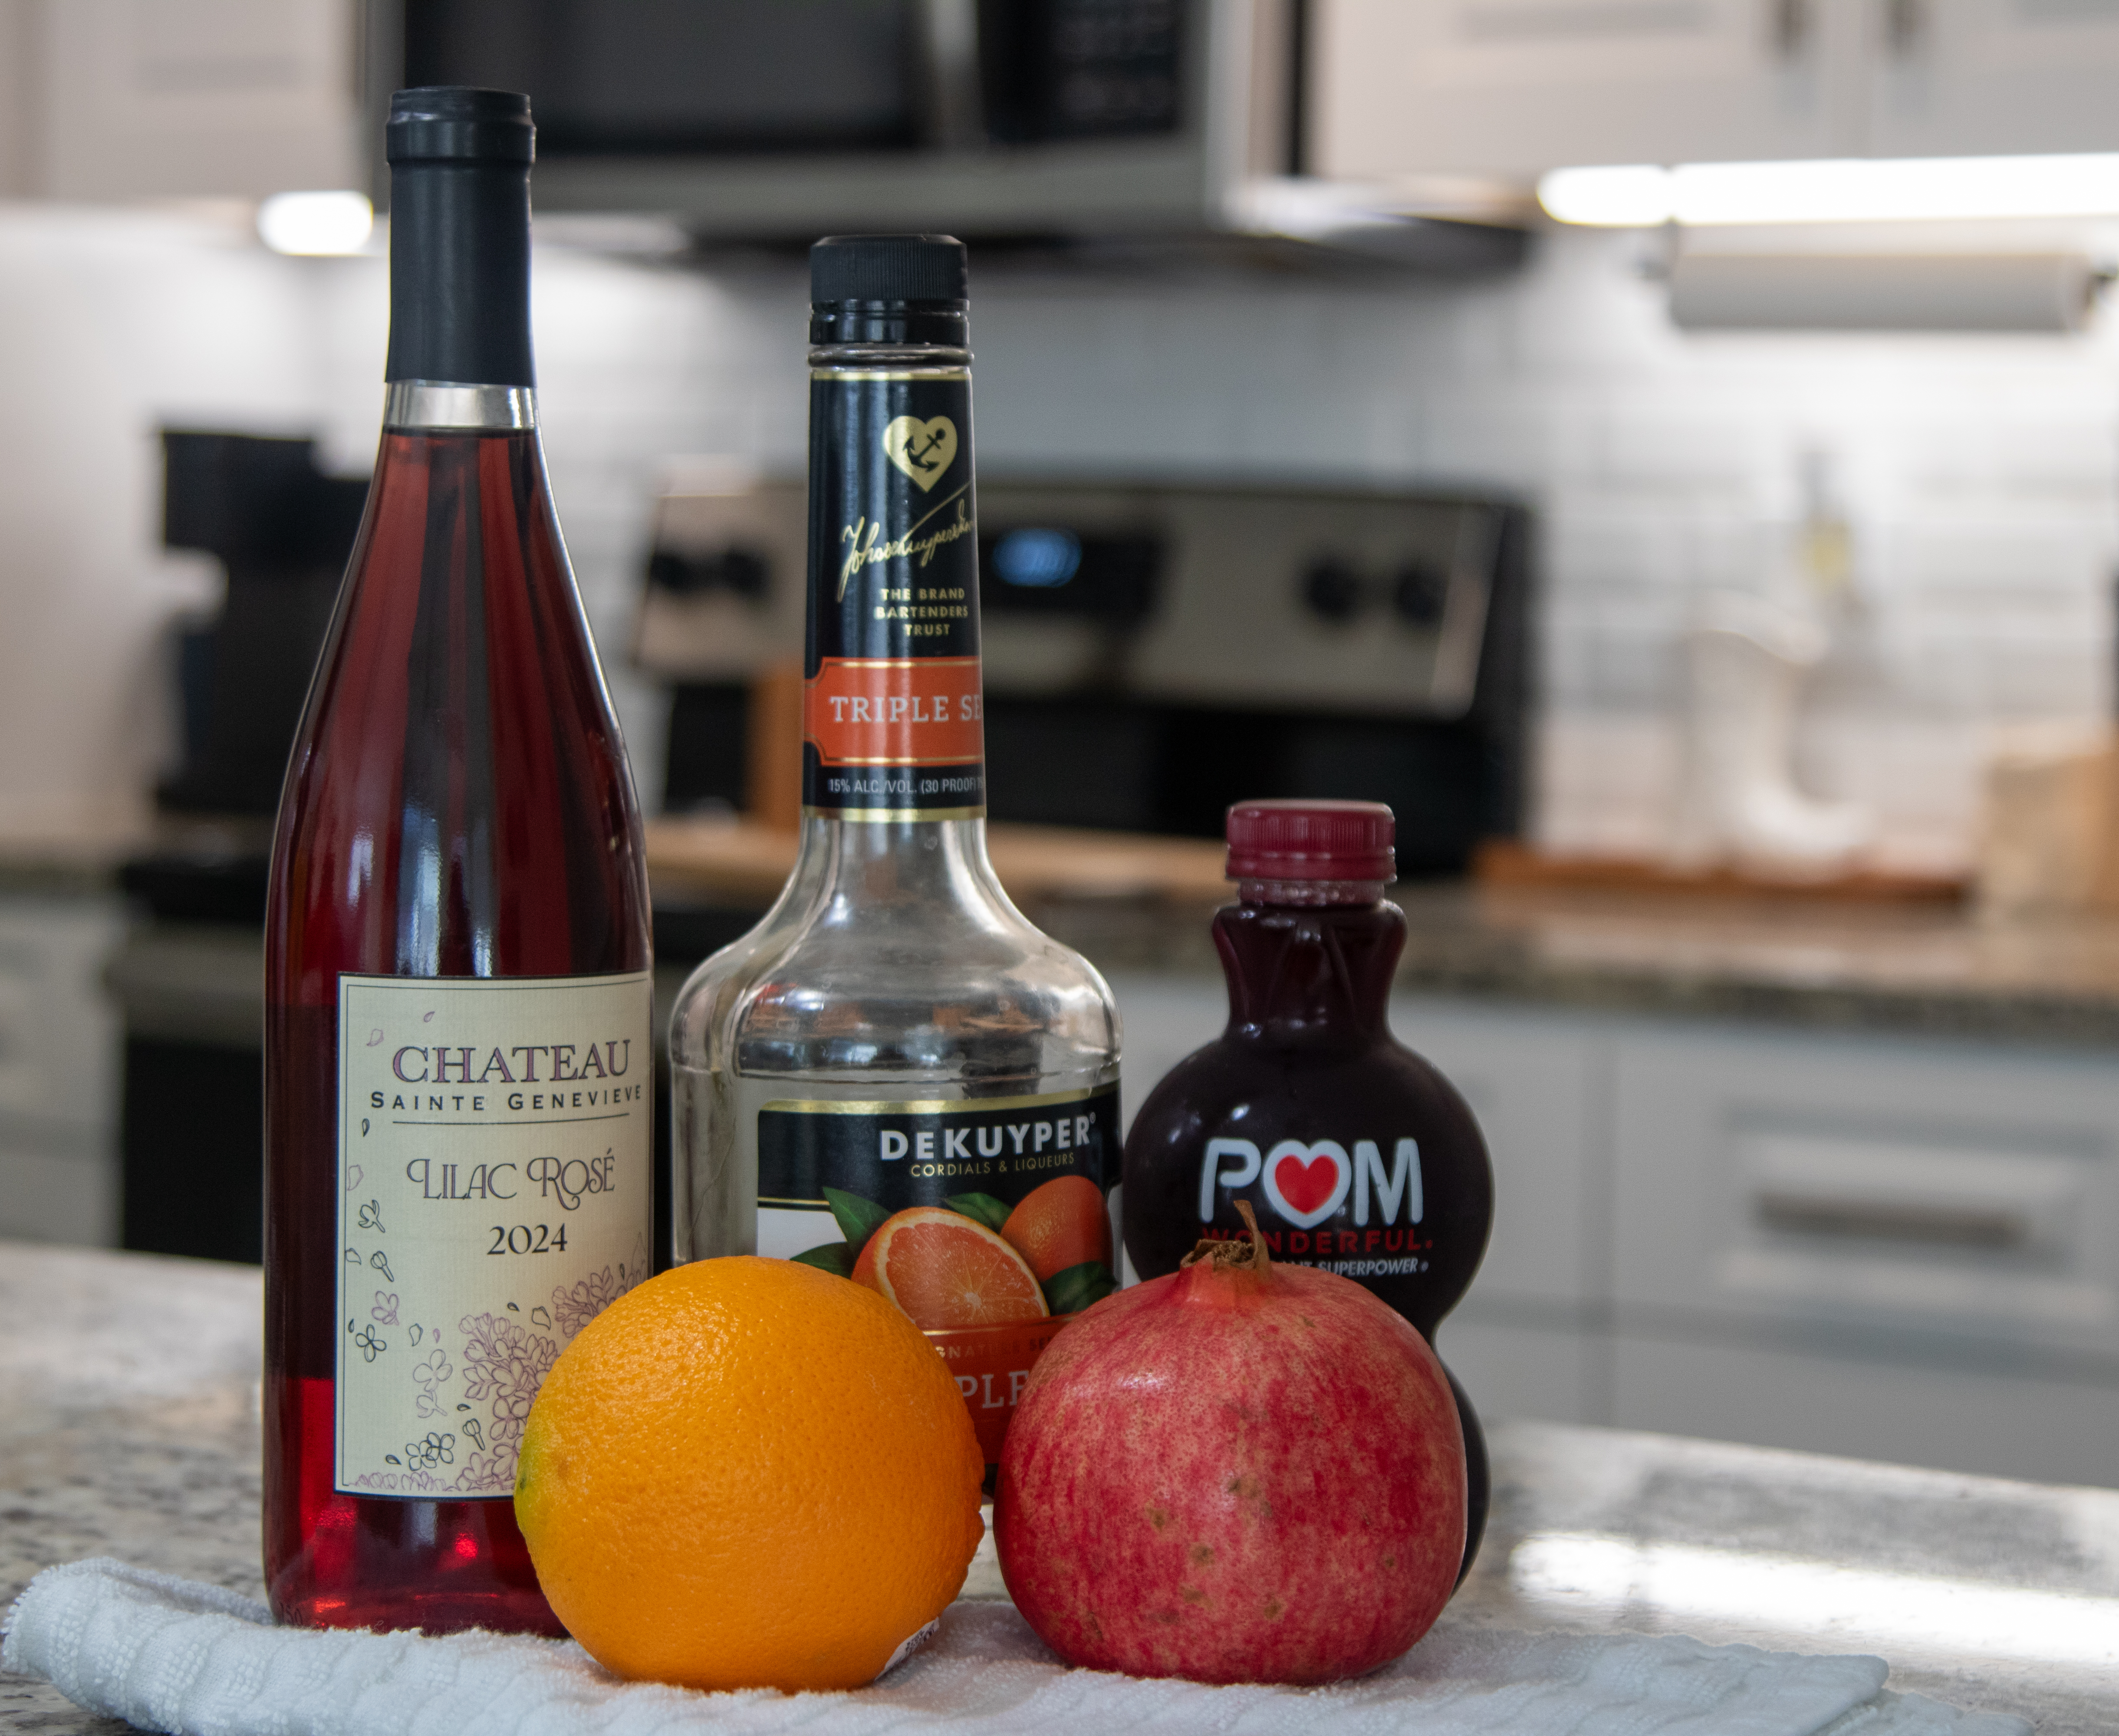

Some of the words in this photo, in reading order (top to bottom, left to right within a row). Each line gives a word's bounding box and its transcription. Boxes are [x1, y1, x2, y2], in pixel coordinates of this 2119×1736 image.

[881, 588, 911, 600] THE
[919, 587, 965, 600] BRAND
[874, 605, 968, 619] BARTENDERS
[904, 624, 950, 637] TRUST
[830, 695, 949, 723] TRIPLE
[960, 694, 982, 722] SE
[829, 778, 851, 793] 15%
[921, 779, 939, 795] (30
[392, 1039, 631, 1083] CHATEAU
[371, 1092, 485, 1111] SAINTE
[508, 1085, 641, 1111] GENEVIEVE
[911, 1162, 991, 1178] CORDIALS
[999, 1160, 1007, 1173] &
[1016, 1152, 1075, 1171] LIQUEURS
[407, 1158, 517, 1200] LILAC
[526, 1147, 616, 1211] ROSÉ
[1199, 1136, 1424, 1230] POM
[487, 1222, 568, 1255] 2024
